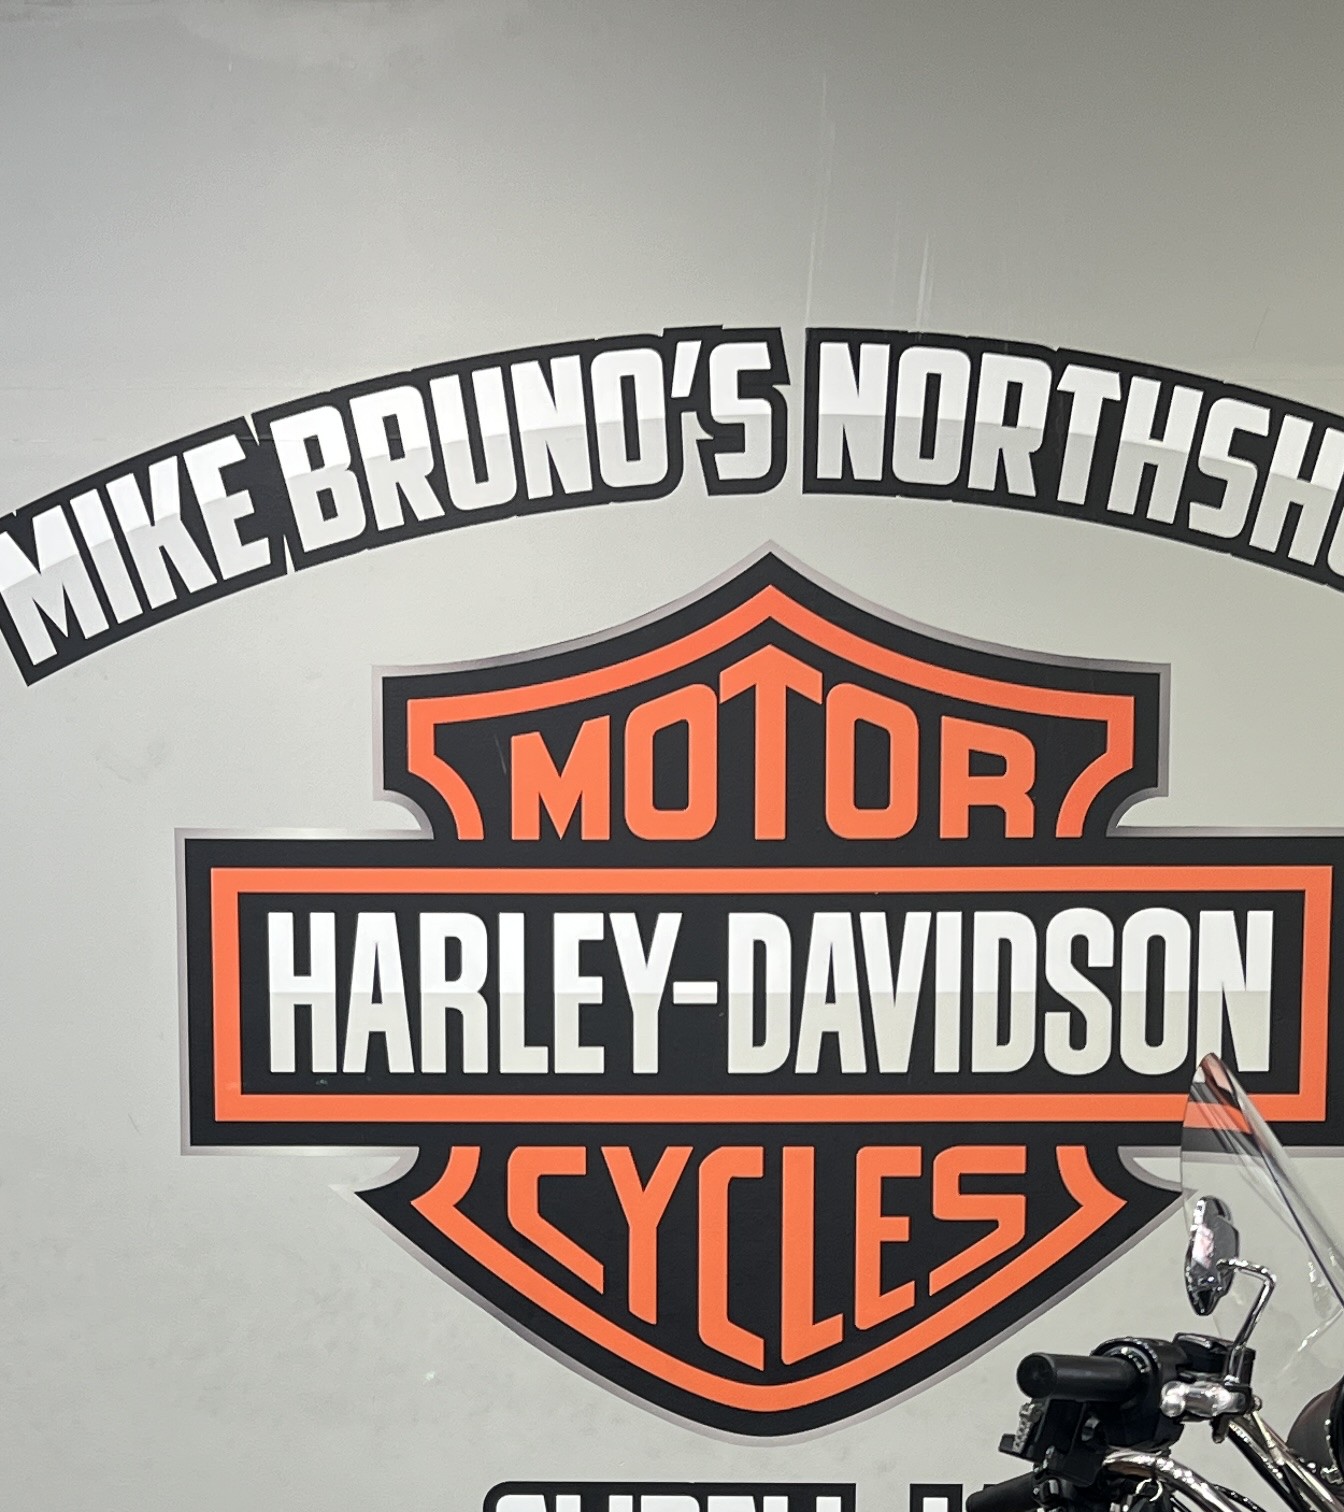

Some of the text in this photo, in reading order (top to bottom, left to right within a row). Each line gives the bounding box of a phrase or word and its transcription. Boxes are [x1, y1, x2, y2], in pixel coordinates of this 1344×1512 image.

[268, 340, 777, 540] BRUNO'S
[511, 645, 1037, 840] MOTOR
[267, 908, 1273, 1076] HARLEY-DAVIDSON
[507, 1146, 1026, 1372] CYCLES
